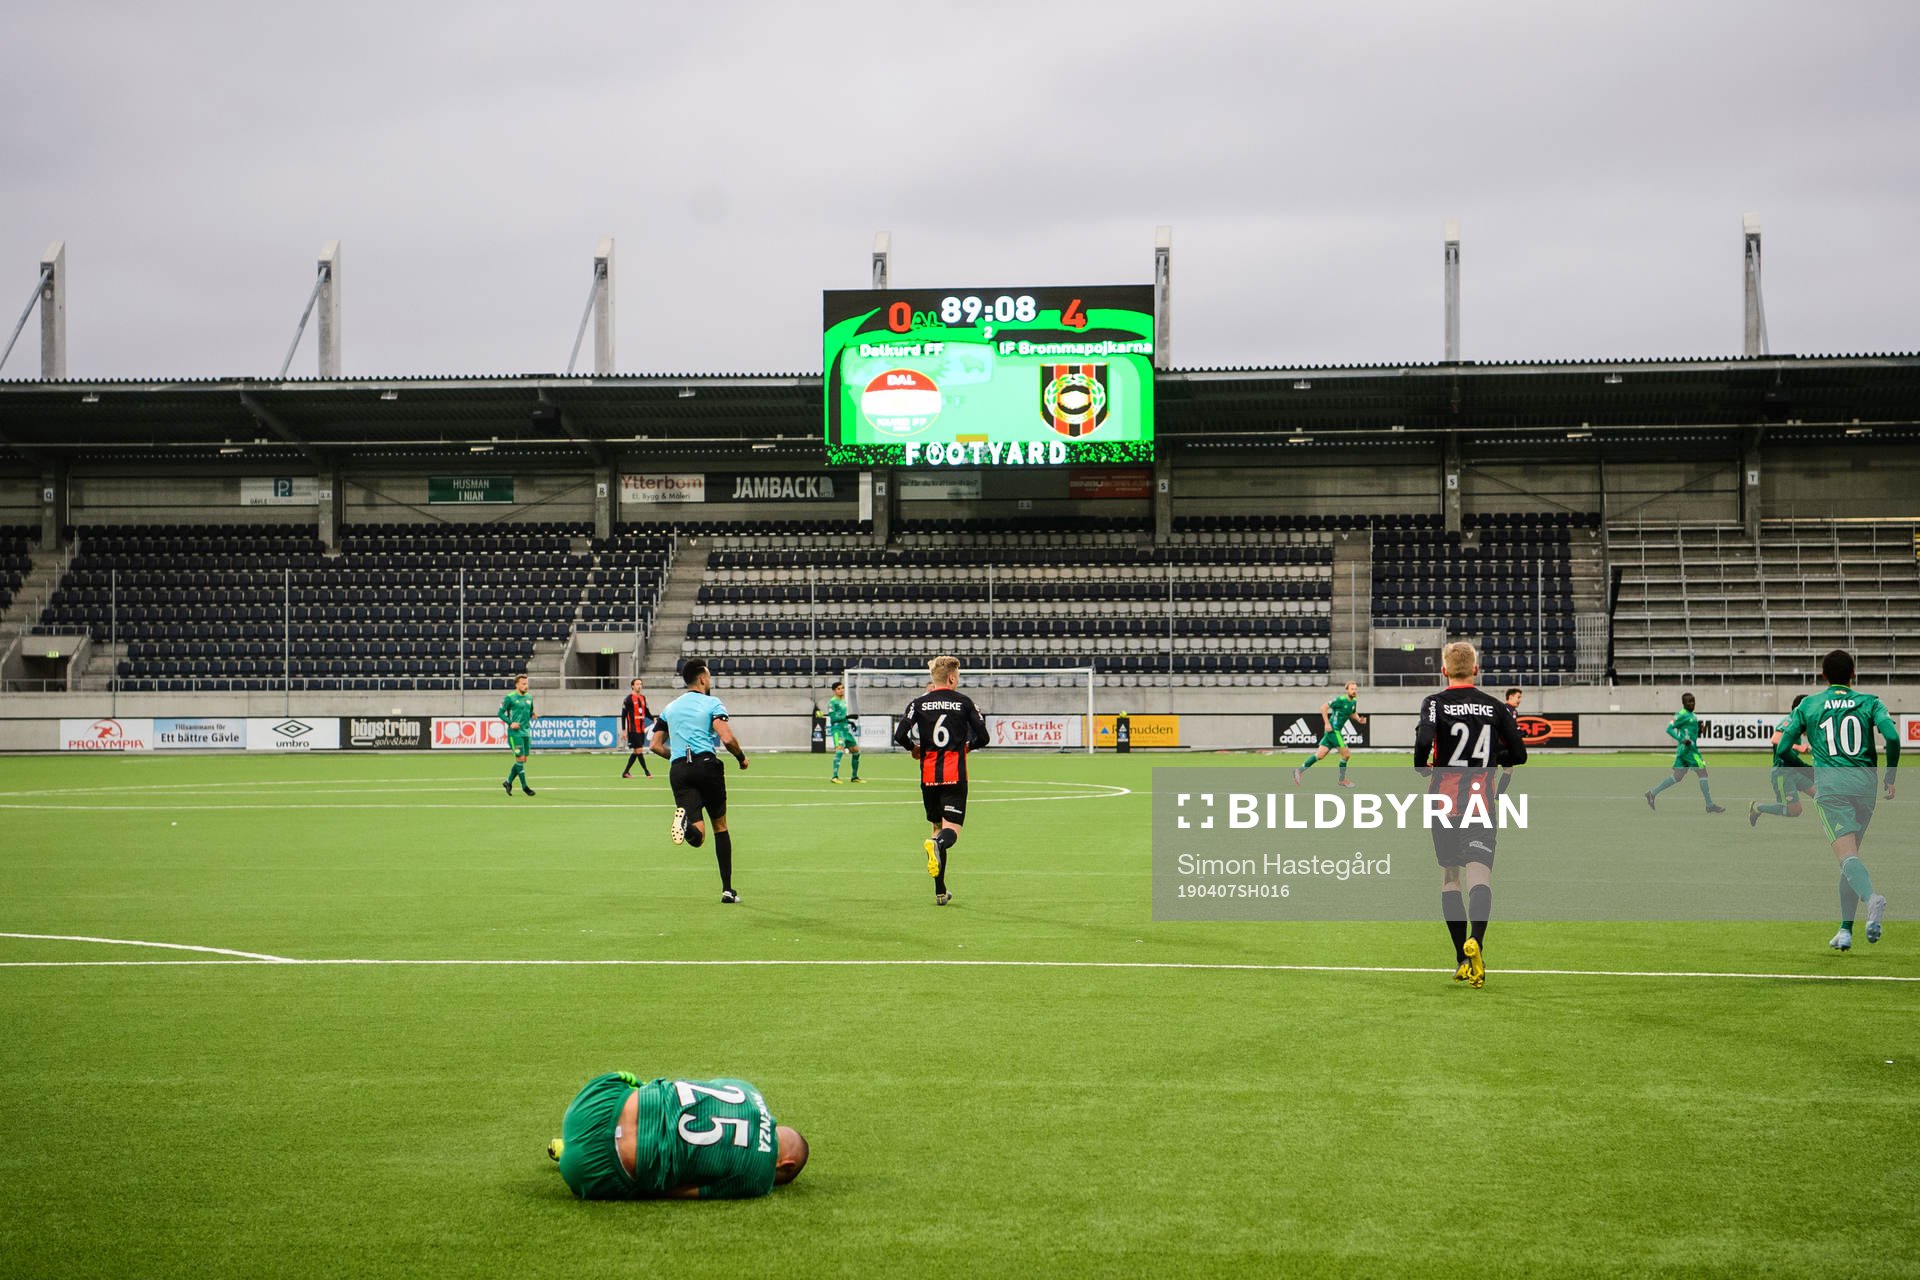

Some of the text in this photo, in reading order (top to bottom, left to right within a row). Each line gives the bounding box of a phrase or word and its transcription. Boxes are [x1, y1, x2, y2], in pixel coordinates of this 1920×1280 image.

[941, 295, 1037, 323] 89:08
[1061, 299, 1087, 329] 4
[888, 301, 911, 333] 0
[983, 326, 993, 339] 2
[859, 342, 945, 357] Dalkurd FF
[999, 341, 1154, 357] IF Brommapojkarna
[905, 440, 1067, 466] FOOTYARD
[453, 479, 490, 489] HUSMAN
[622, 475, 703, 489] Ytterbom
[732, 477, 820, 499] JAMBACK
[1160, 482, 1167, 492] S
[1449, 478, 1456, 487] S
[922, 701, 962, 711] SERNEKE
[1443, 703, 1494, 717] SERNEKE
[1824, 700, 1856, 709] AWAD
[175, 723, 226, 731] Tillsammans för
[351, 718, 420, 740] högström
[529, 717, 596, 729] VARNING FÖR
[1011, 720, 1064, 731] Gästrike
[161, 732, 240, 743] Ett bättre Gävle
[529, 729, 597, 738] INSPIRATION
[932, 714, 950, 748] 6
[1042, 731, 1062, 741] AB
[1820, 715, 1863, 756] 10
[68, 739, 145, 749] PROLYMPIA
[276, 740, 310, 748] umbro
[1280, 734, 1318, 744] adidas
[1447, 722, 1492, 768] 24
[674, 1080, 749, 1147] 25
